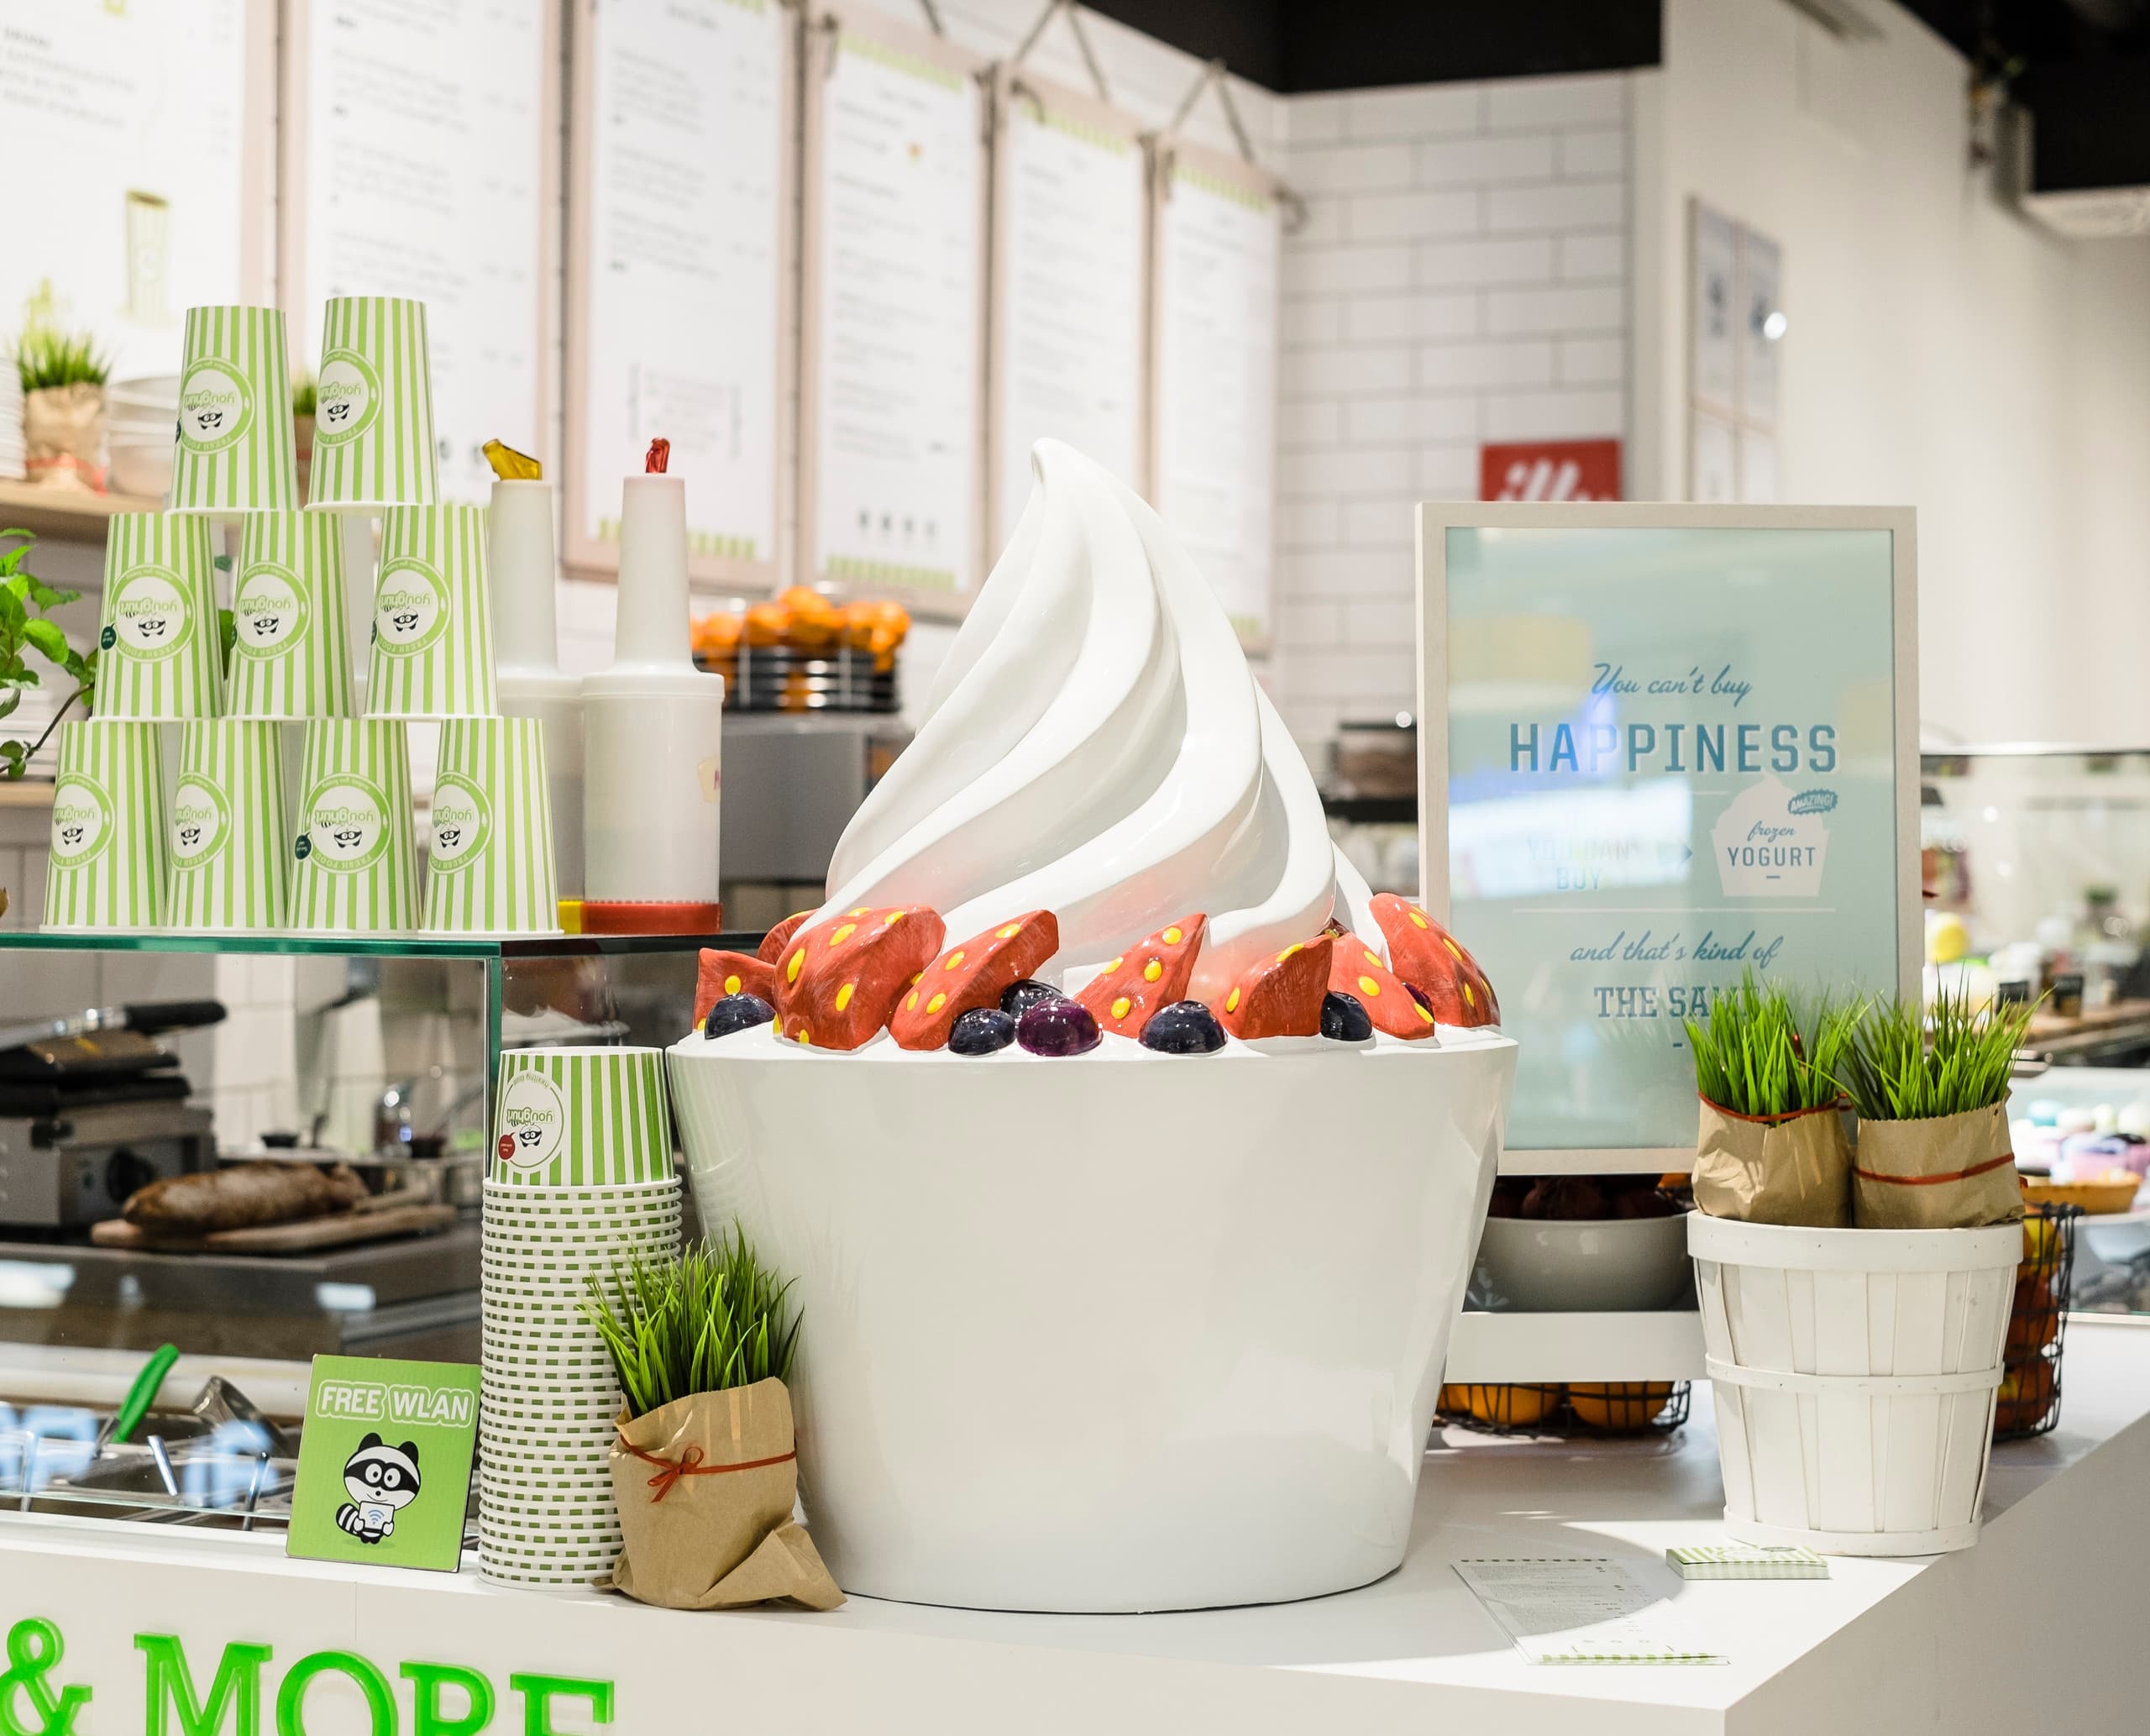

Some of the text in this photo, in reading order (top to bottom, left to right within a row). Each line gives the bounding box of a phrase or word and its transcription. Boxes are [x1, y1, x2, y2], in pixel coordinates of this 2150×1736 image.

[320, 381, 361, 401] youghu
[1496, 458, 1613, 501] ill
[1592, 663, 1752, 709] You can't buy
[1510, 723, 1837, 773] HAPPINESS
[1791, 794, 1834, 812] AMAZING!
[1747, 821, 1796, 842] frozen
[1727, 847, 1816, 867] YOGURT
[1556, 868, 1602, 890] BUY
[1570, 930, 1784, 969] and that's kind of
[1594, 986, 1760, 1018] THE SA
[321, 1386, 469, 1421] FREE WLAN
[0, 1617, 92, 1736] &
